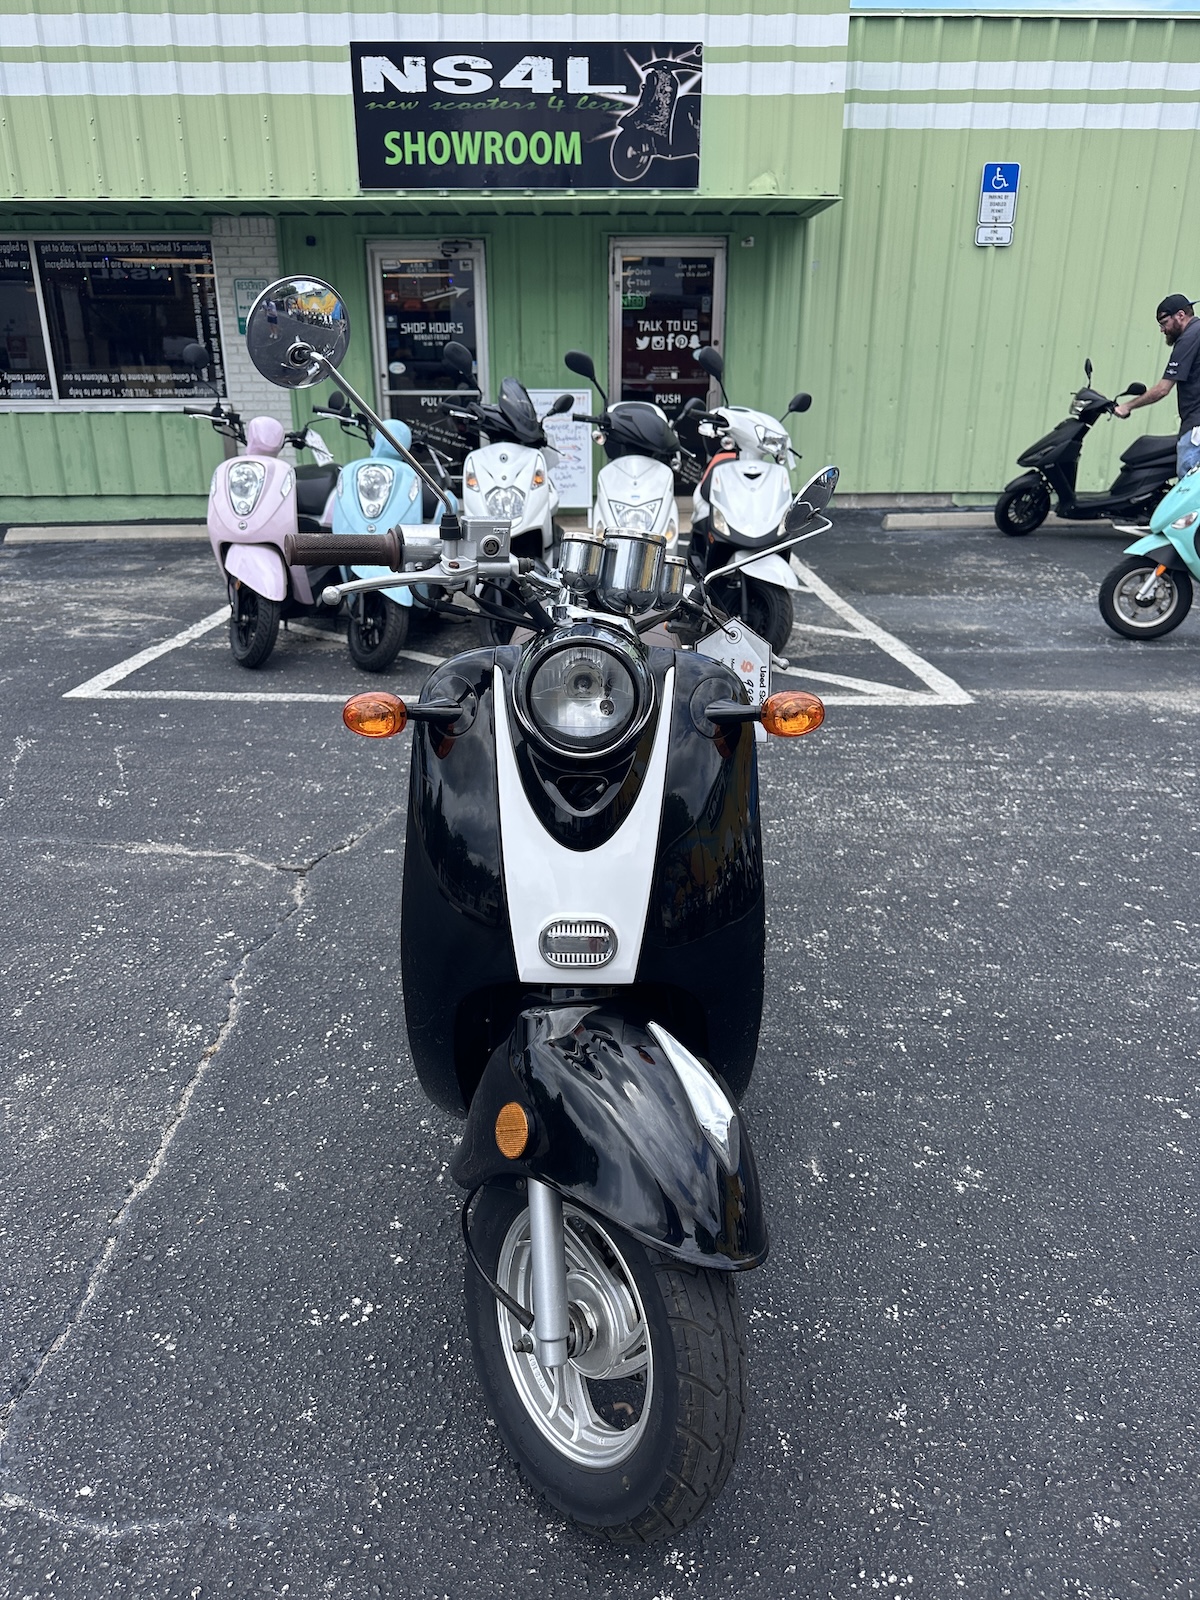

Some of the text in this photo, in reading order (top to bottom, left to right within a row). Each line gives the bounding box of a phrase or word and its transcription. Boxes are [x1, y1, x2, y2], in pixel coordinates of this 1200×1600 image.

[360, 54, 627, 94] NS4L
[365, 96, 626, 112] new scooters 4 less
[384, 130, 582, 166] SHOWROOM
[400, 322, 426, 334] SHOP
[428, 322, 464, 334] HOURS
[637, 320, 698, 332] TALK TO US
[655, 394, 681, 404] PUSH
